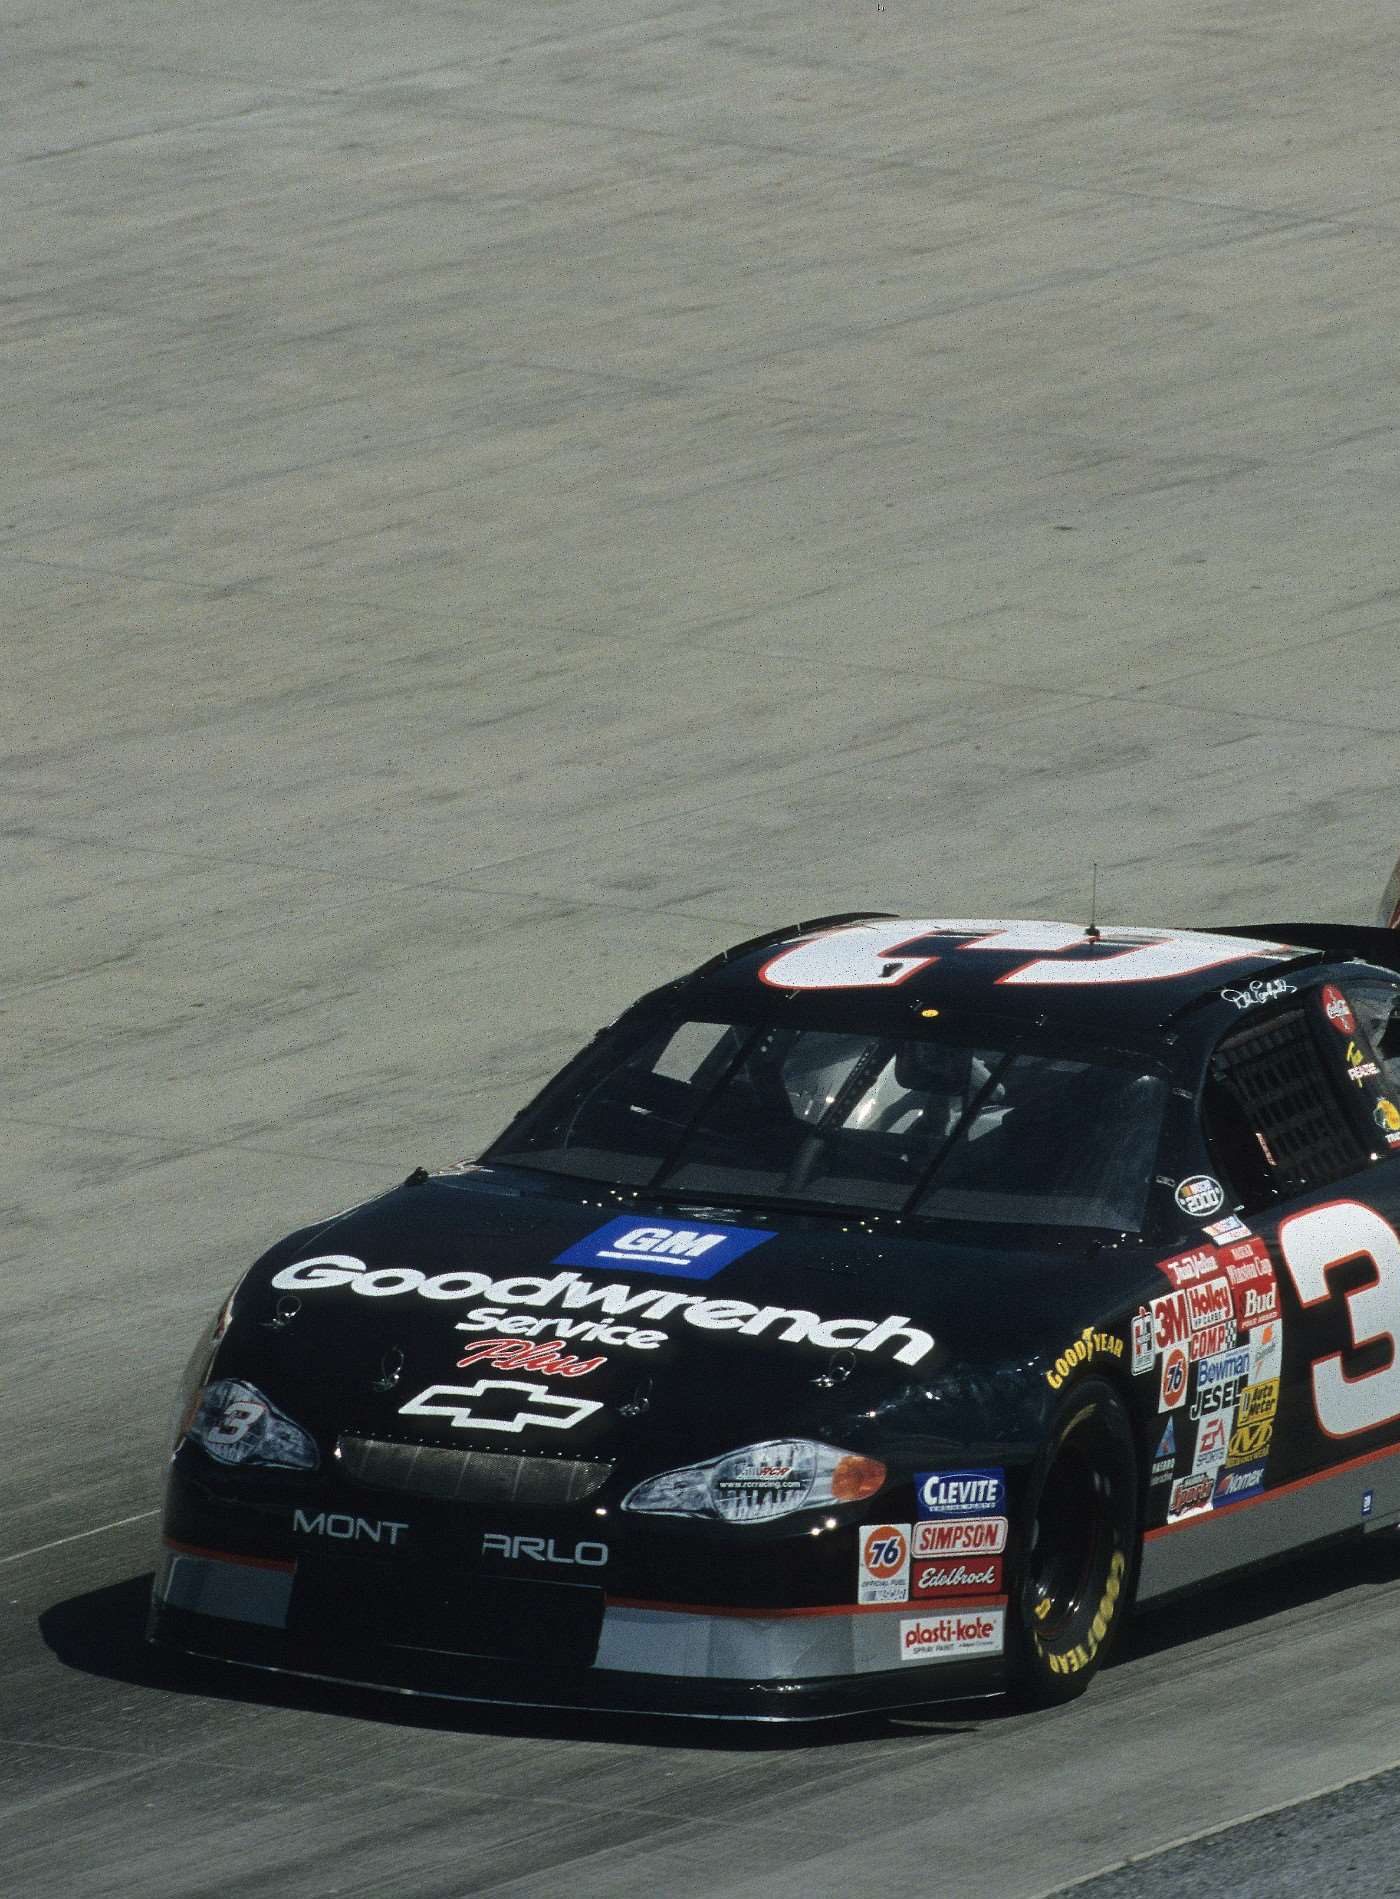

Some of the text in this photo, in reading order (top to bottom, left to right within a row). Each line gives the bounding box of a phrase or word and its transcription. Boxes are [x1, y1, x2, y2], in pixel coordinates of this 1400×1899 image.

[613, 1226, 728, 1257] GM
[271, 1254, 936, 1367] Goodwrench
[1244, 1282, 1277, 1319] Bud
[455, 1307, 670, 1351] Service
[1155, 1293, 1190, 1348] 3M
[455, 1336, 608, 1379] Plus
[1045, 1326, 1124, 1389] GOODYEAR
[1190, 1324, 1226, 1361] COMP
[1165, 1359, 1186, 1395] 76
[1199, 1352, 1250, 1386] Bowman
[207, 1400, 267, 1446] 3
[923, 1475, 999, 1506] CLEVITE
[293, 1509, 410, 1545] MONT
[919, 1523, 999, 1551] SIMPSON
[869, 1535, 902, 1569] 76
[918, 1564, 995, 1589] Edelbrock
[905, 1616, 994, 1649] plasti-kote
